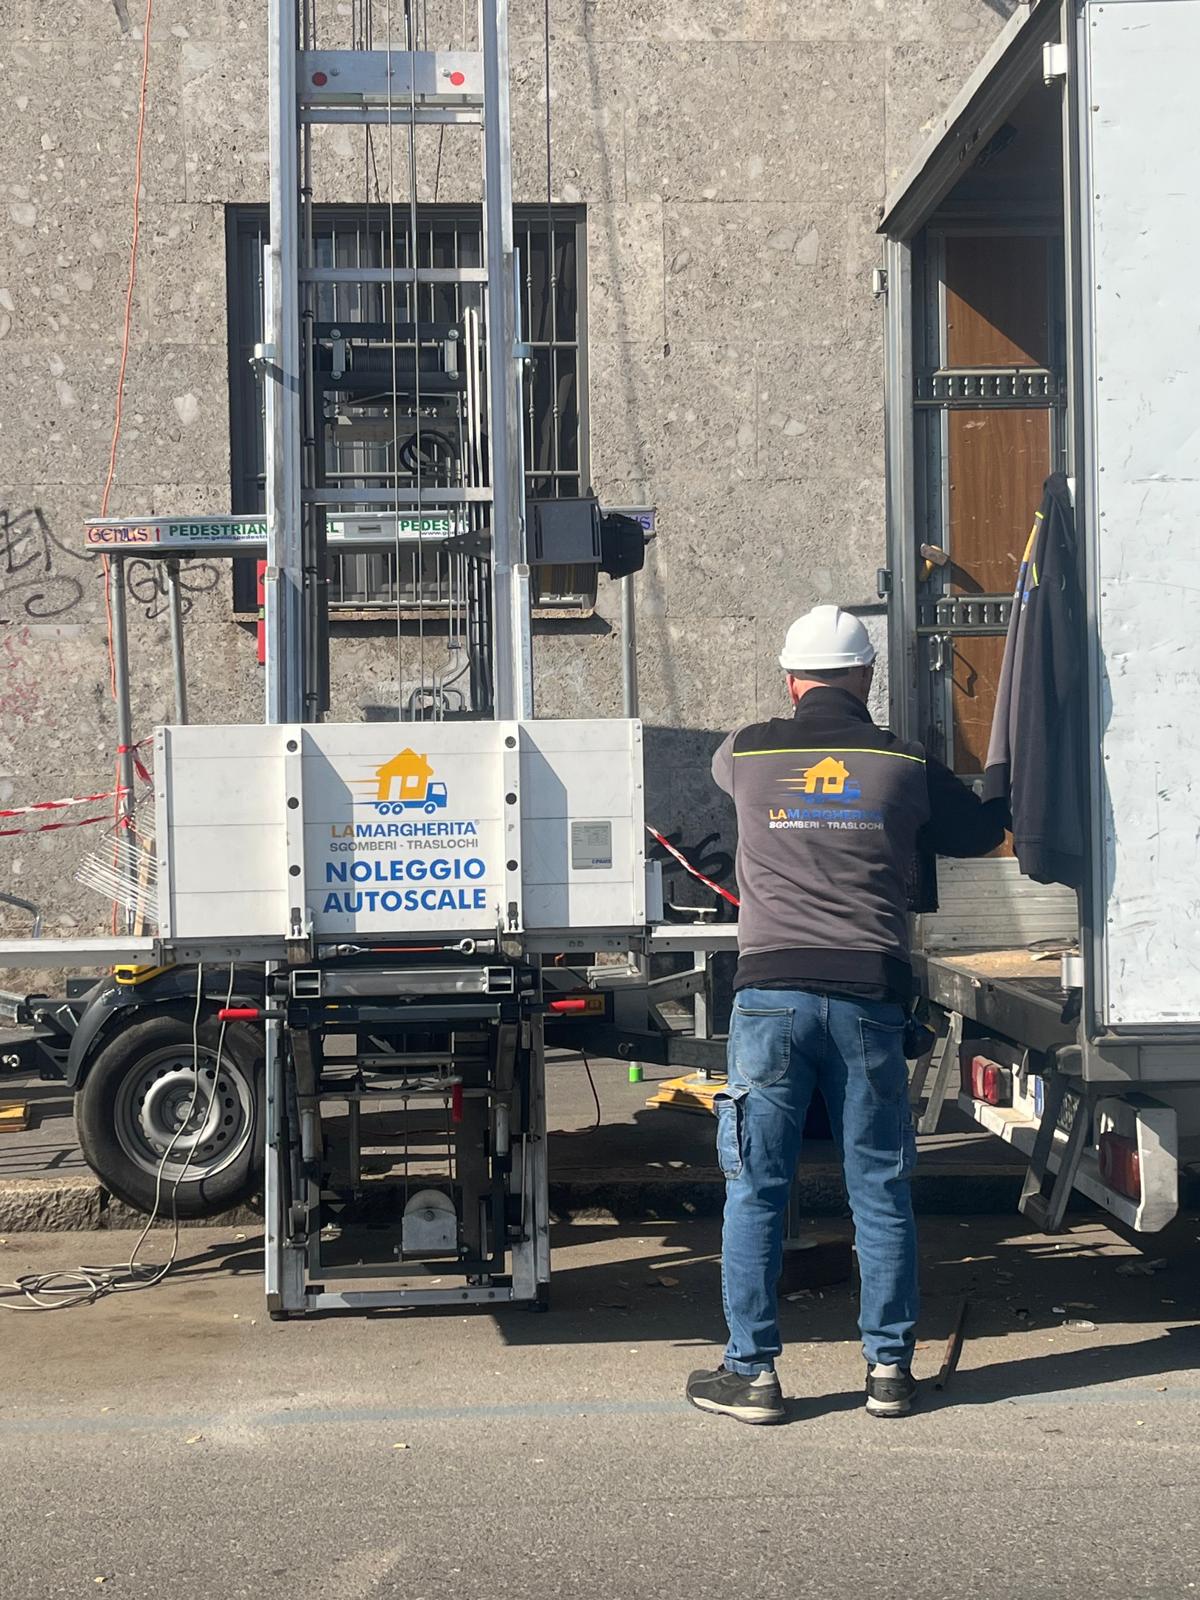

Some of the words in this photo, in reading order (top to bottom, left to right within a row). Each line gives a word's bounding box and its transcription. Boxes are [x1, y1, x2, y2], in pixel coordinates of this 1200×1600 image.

[169, 523, 267, 536] PEDESTRIAN
[769, 808, 882, 820] LAMARGHERI
[331, 822, 477, 838] LAMARGHERITA
[768, 821, 820, 829] SGOMBERI
[827, 821, 884, 830] TRASLOCHI
[330, 840, 397, 852] SGOMBERI
[407, 839, 479, 850] TRASLOCHI
[325, 858, 486, 883] NOLEGGIO
[323, 888, 487, 914] AUTOSCALE
